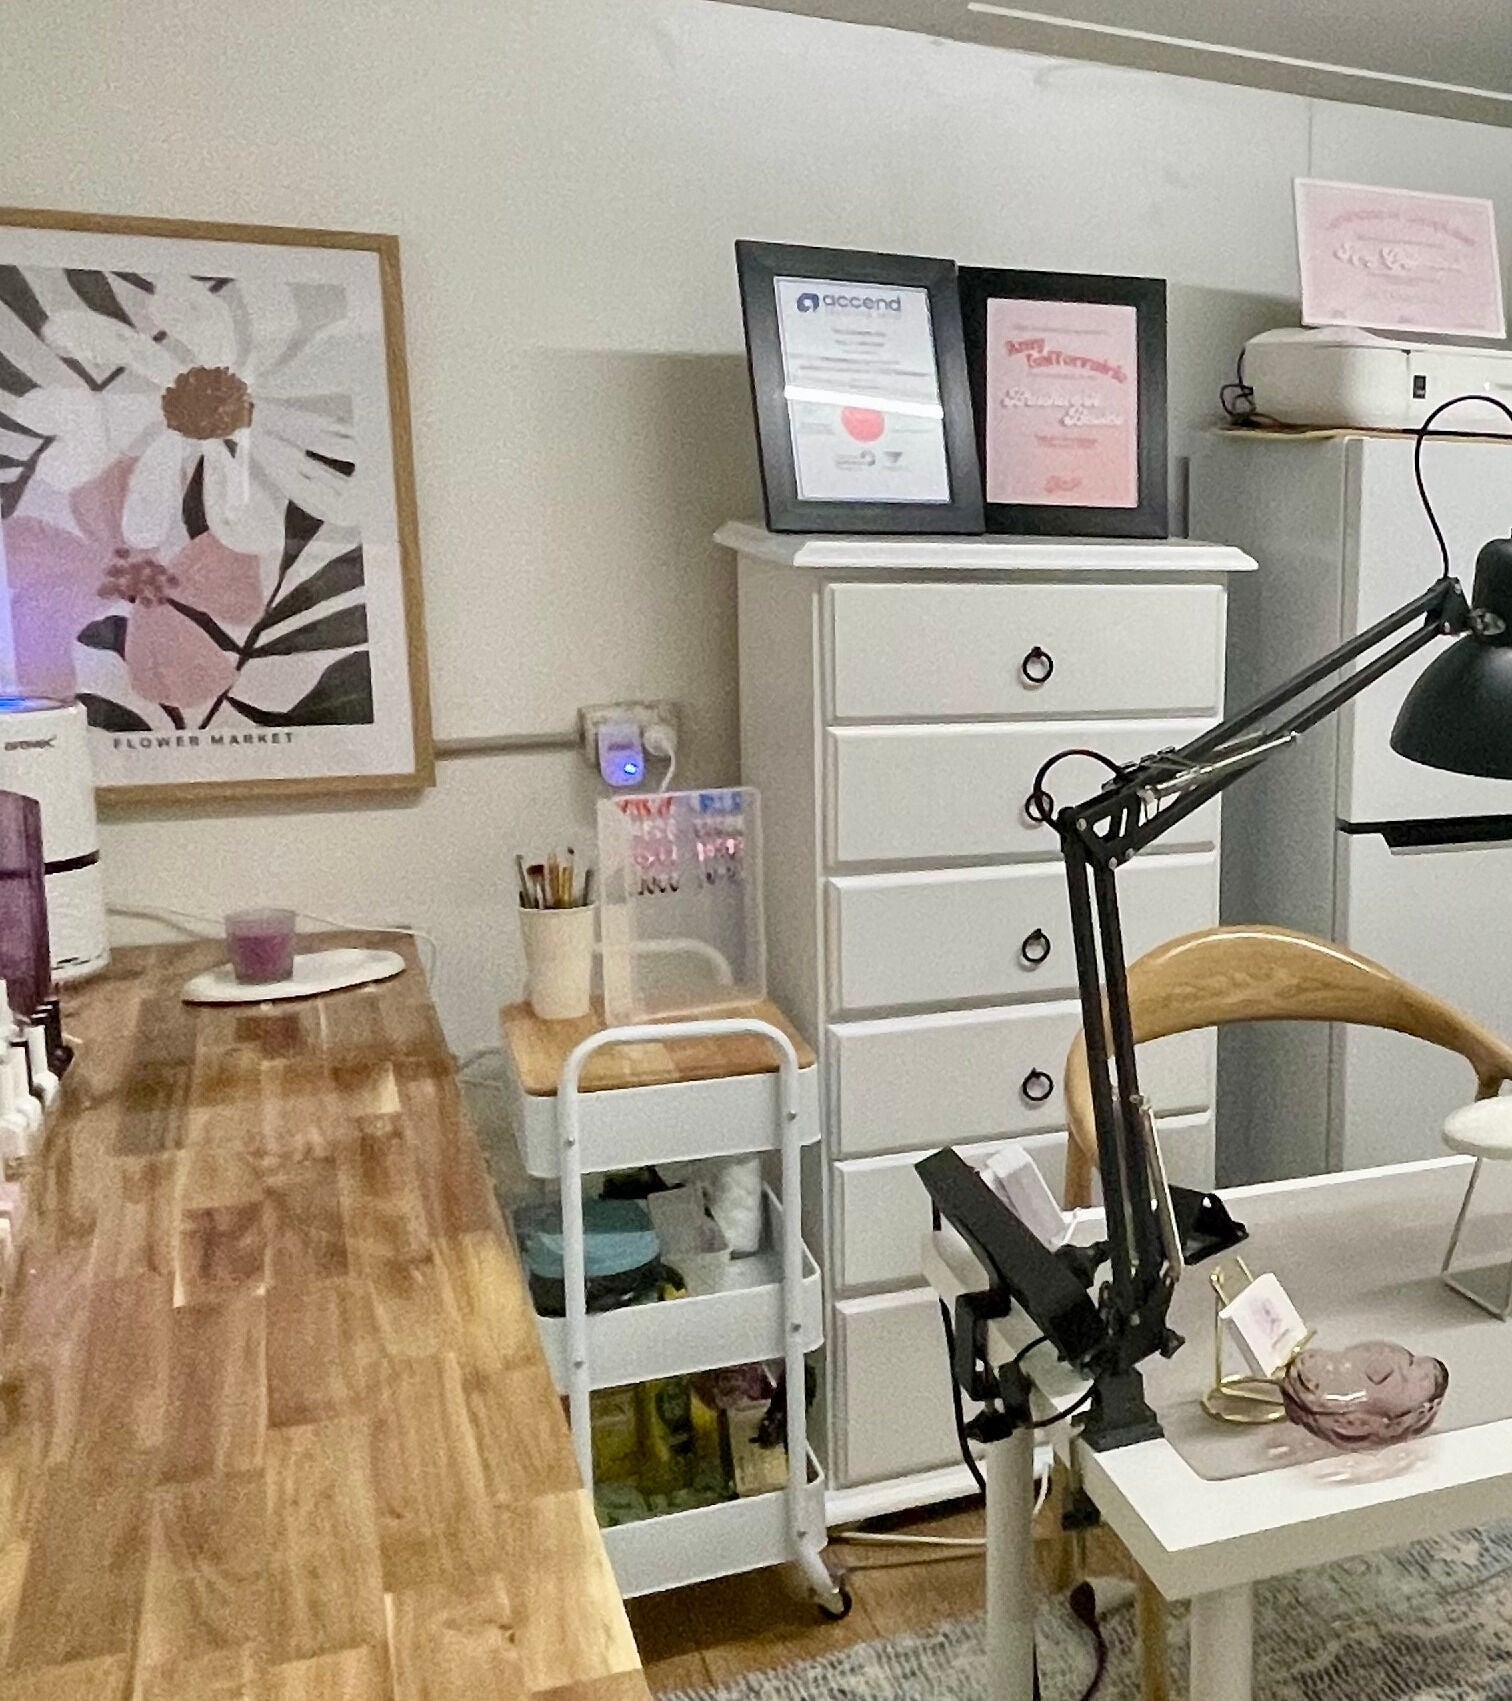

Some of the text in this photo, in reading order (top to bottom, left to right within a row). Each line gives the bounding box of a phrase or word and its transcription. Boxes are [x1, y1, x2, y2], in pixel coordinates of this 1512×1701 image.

[822, 294, 902, 312] accend
[113, 732, 294, 750] FLOWER MARKET
